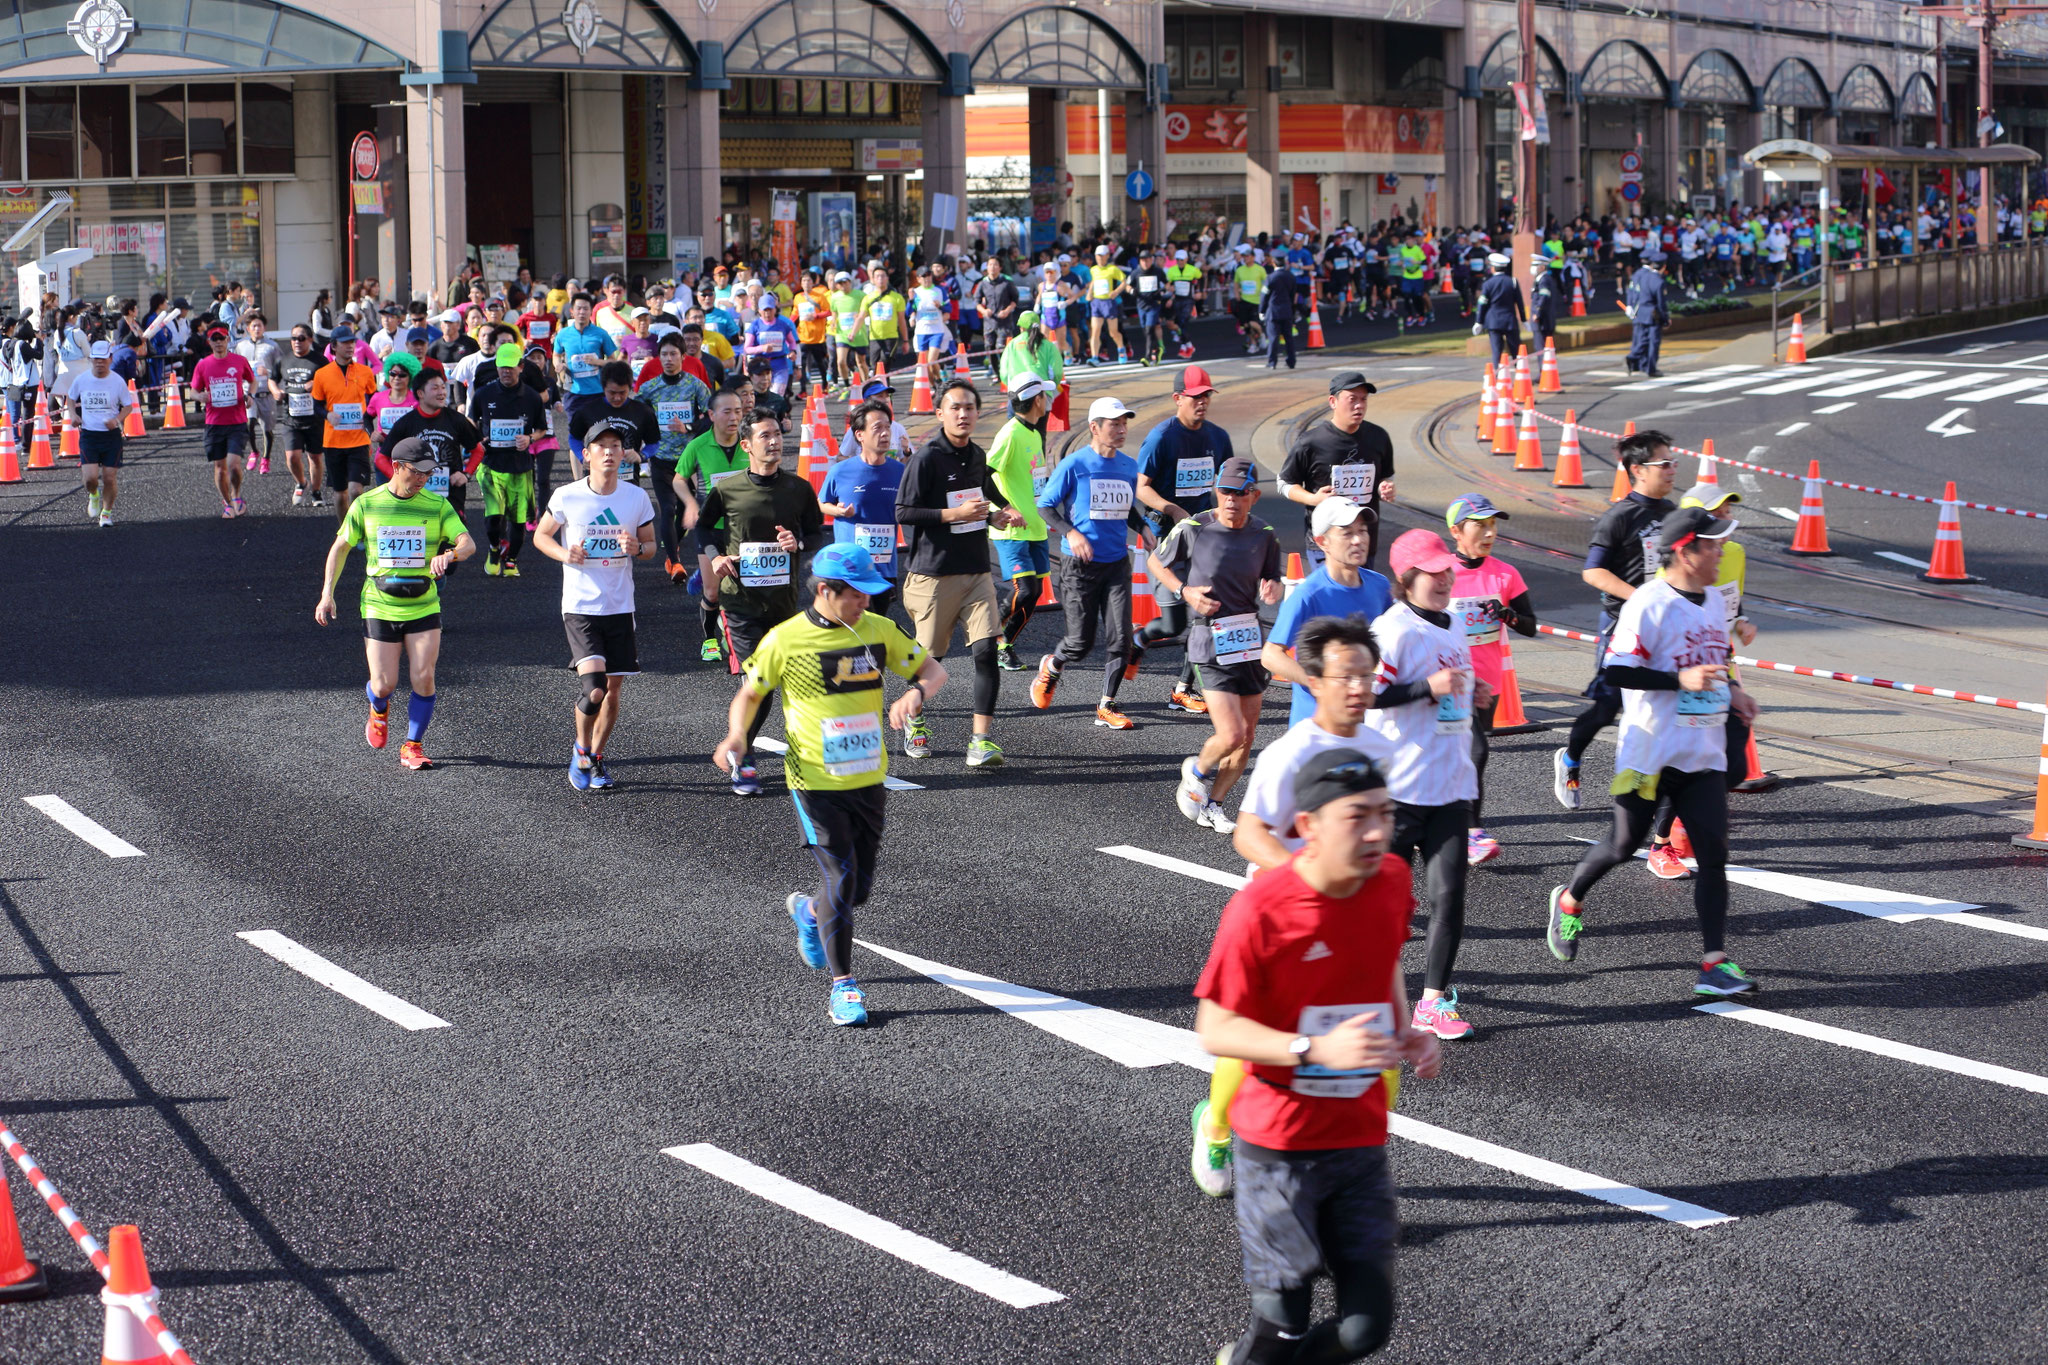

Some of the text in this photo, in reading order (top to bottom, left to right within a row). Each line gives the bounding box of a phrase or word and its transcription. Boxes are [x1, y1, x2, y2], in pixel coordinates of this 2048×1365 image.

[650, 243, 664, 255] 3F
[216, 389, 235, 399] 2422
[88, 397, 107, 405] 3281
[294, 400, 312, 408] 2020
[341, 411, 361, 420] 4168
[498, 428, 521, 436] 4074
[1178, 469, 1212, 482] D 5283
[1343, 477, 1371, 488] 2272
[1093, 491, 1129, 504] B 2101
[379, 539, 422, 551] C 4713
[591, 539, 622, 551] 708
[870, 537, 889, 547] 523
[742, 555, 786, 569] C 4009
[1217, 627, 1258, 646] C 4828
[825, 733, 878, 753] C 4965
